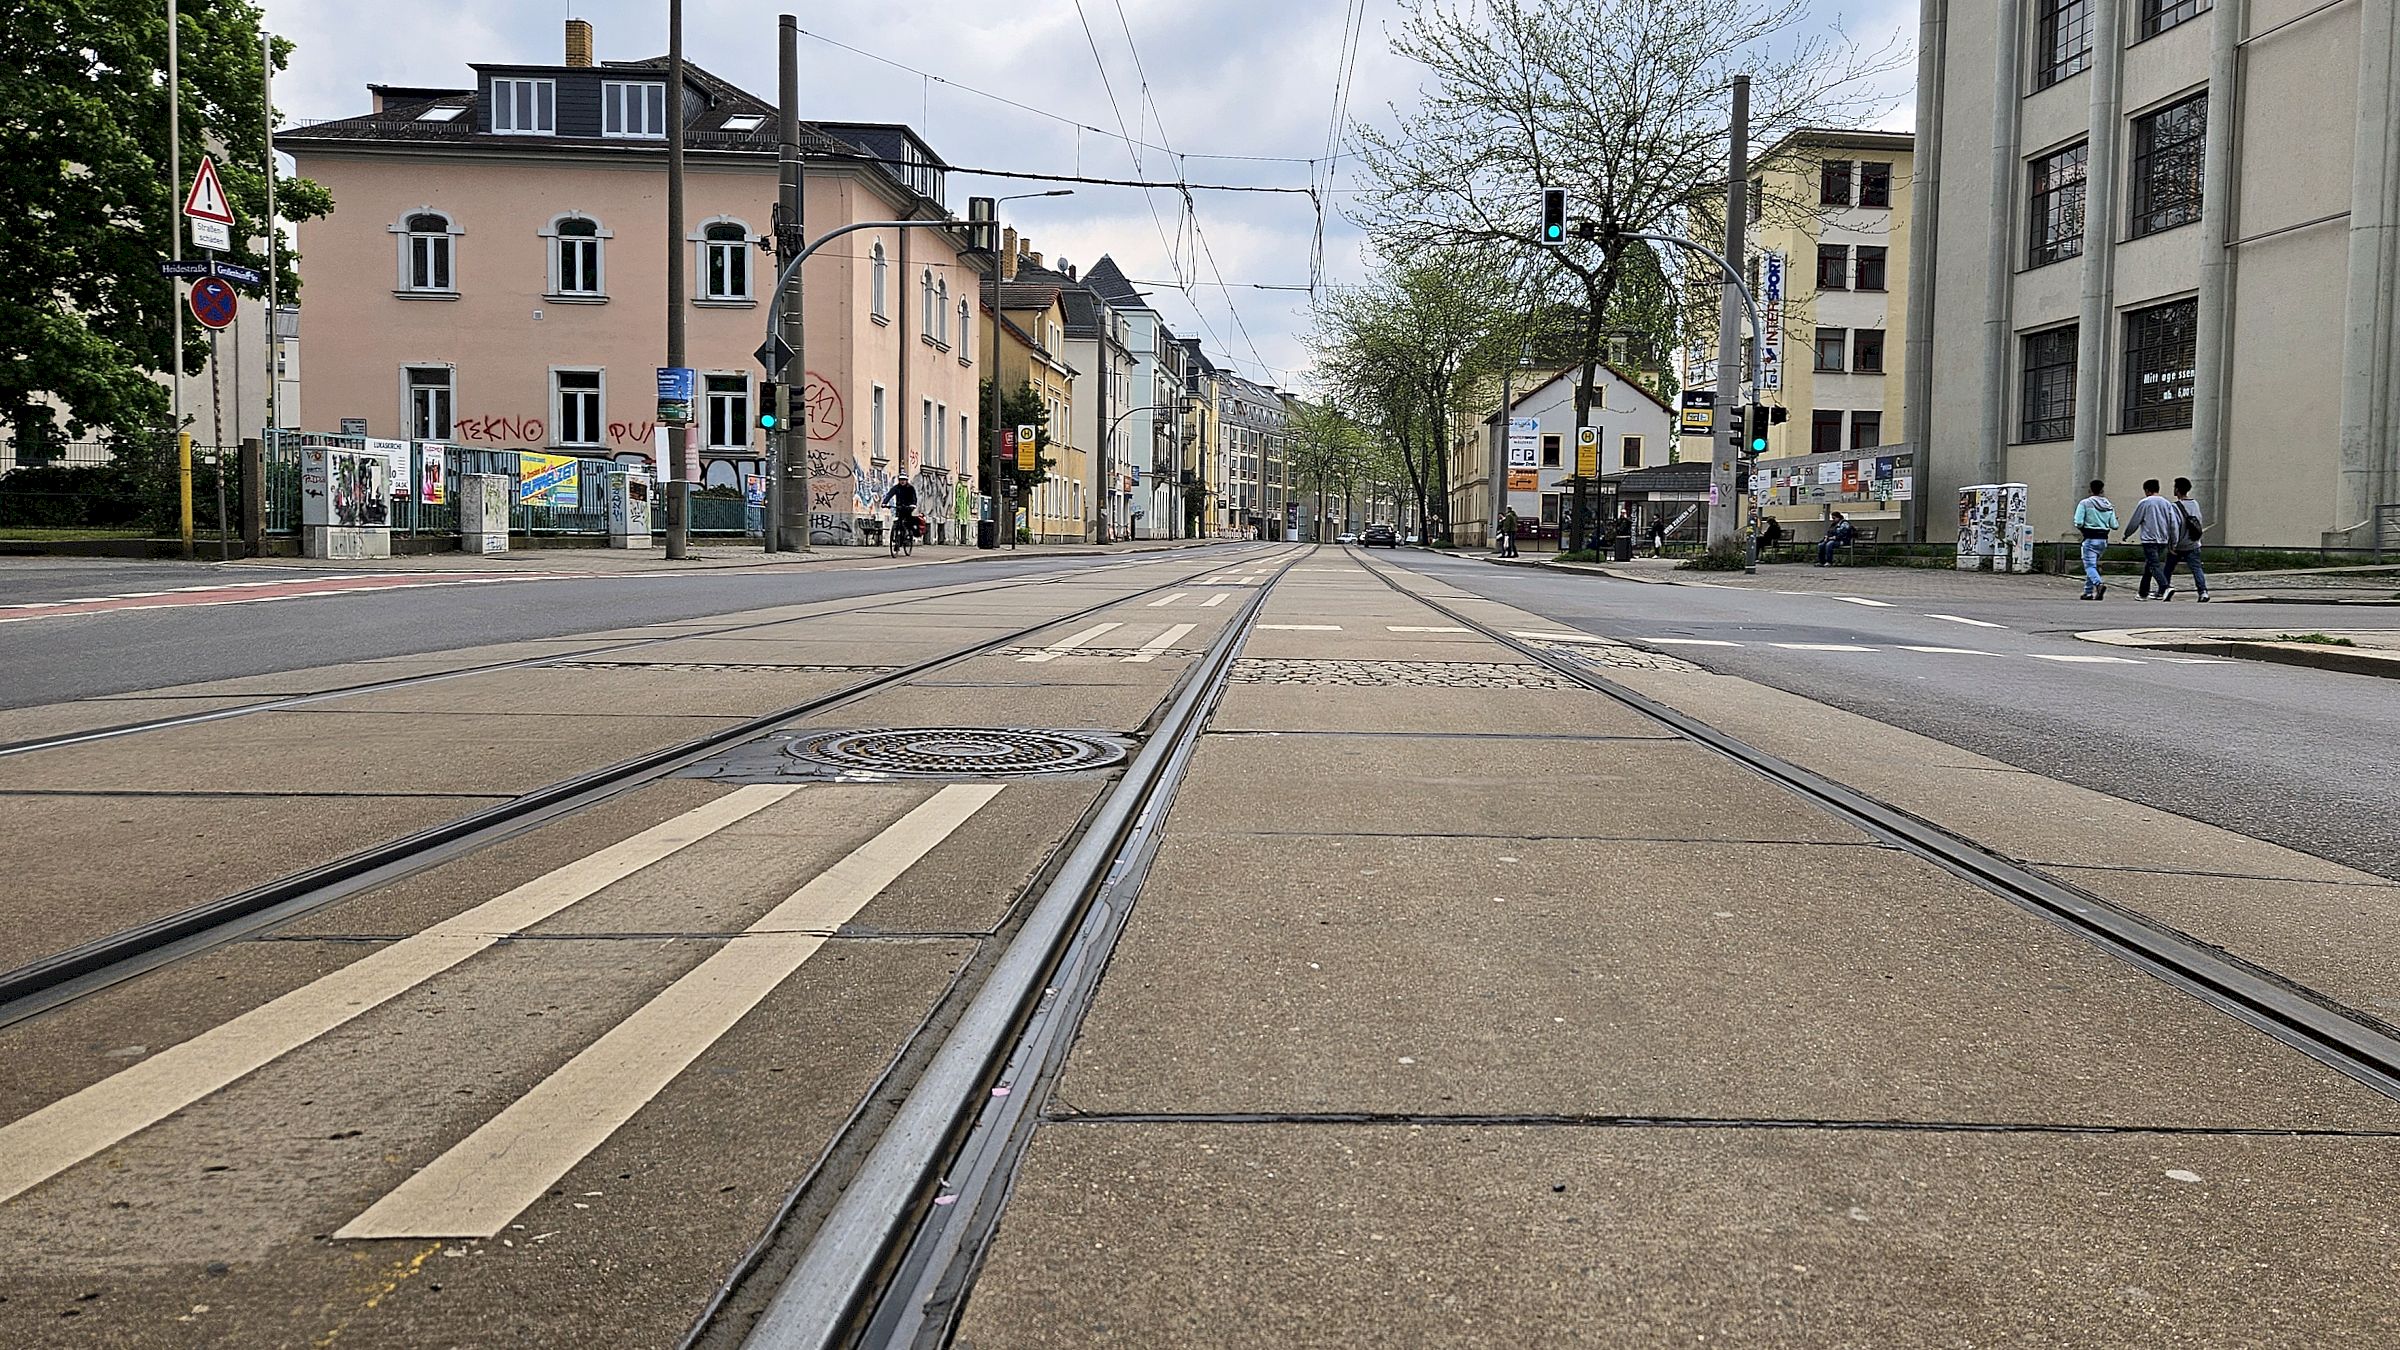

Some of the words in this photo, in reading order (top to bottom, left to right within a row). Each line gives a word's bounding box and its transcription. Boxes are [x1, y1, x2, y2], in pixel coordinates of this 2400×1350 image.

[162, 264, 208, 273] Heidestraße
[1766, 255, 1781, 345] INTERSPORT
[454, 414, 544, 442] TEKNO
[521, 461, 577, 498] BUMMELZEIT
